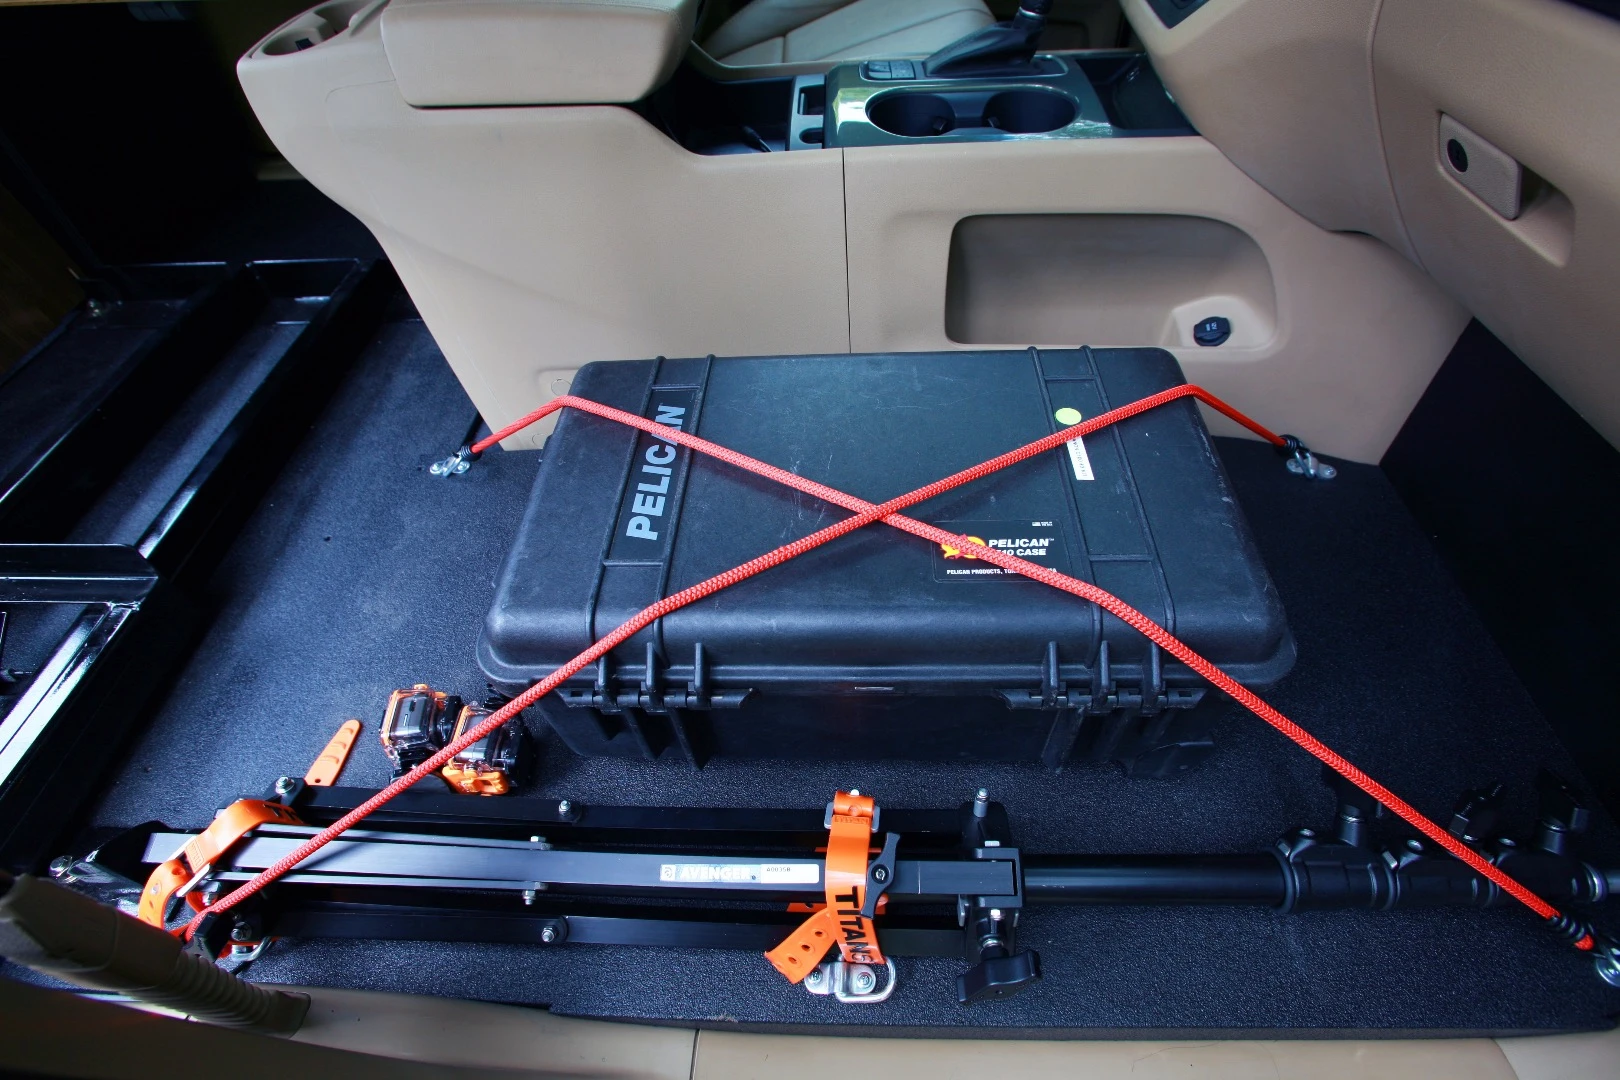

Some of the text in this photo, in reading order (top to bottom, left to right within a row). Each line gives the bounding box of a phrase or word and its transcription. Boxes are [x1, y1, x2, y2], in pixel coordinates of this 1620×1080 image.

[626, 405, 686, 540] PELICN
[1016, 548, 1046, 556] CASE
[679, 865, 751, 880] AVENGER
